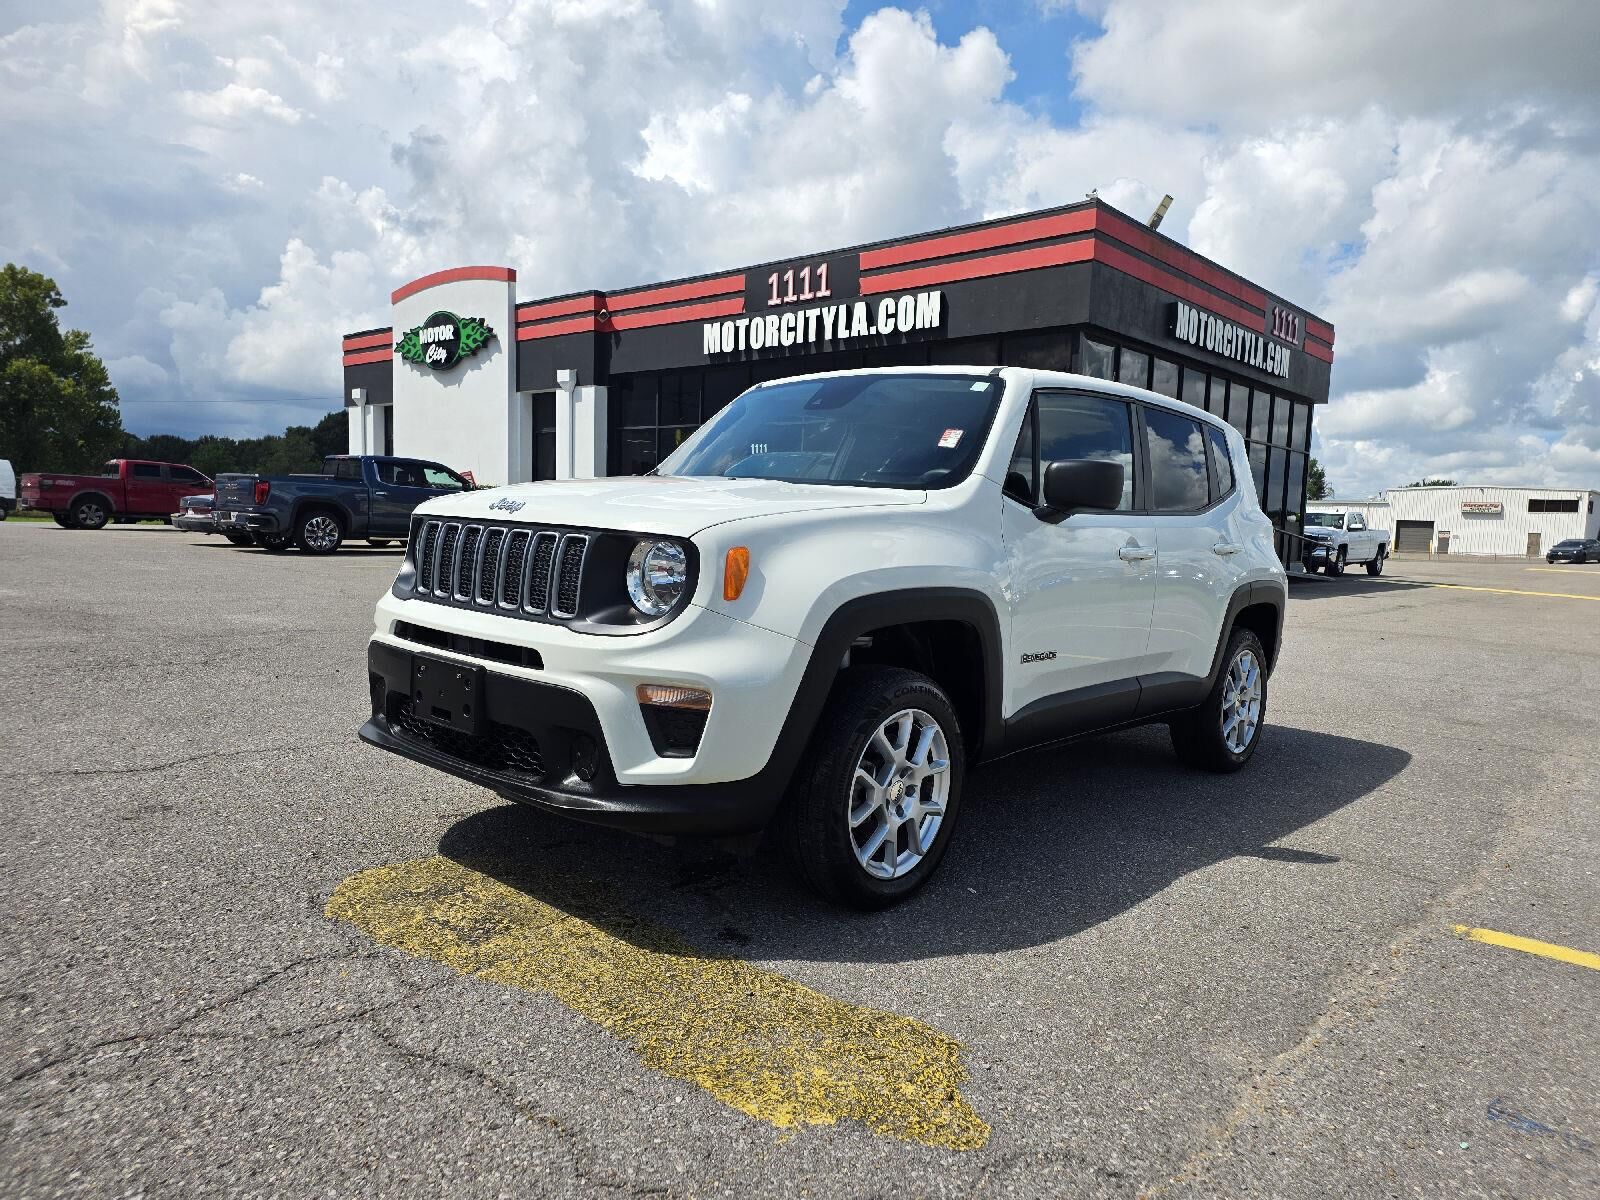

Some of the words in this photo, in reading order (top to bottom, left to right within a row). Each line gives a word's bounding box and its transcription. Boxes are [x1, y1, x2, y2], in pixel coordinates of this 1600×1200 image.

[767, 262, 832, 306] 1111
[419, 324, 455, 345] MOTOR
[703, 291, 941, 354] MOTORCITYLA.COM
[1175, 301, 1291, 379] MOTORCITYLA.COM
[1271, 305, 1299, 345] 1111
[425, 343, 448, 364] City
[1020, 650, 1058, 664] RENEGADE
